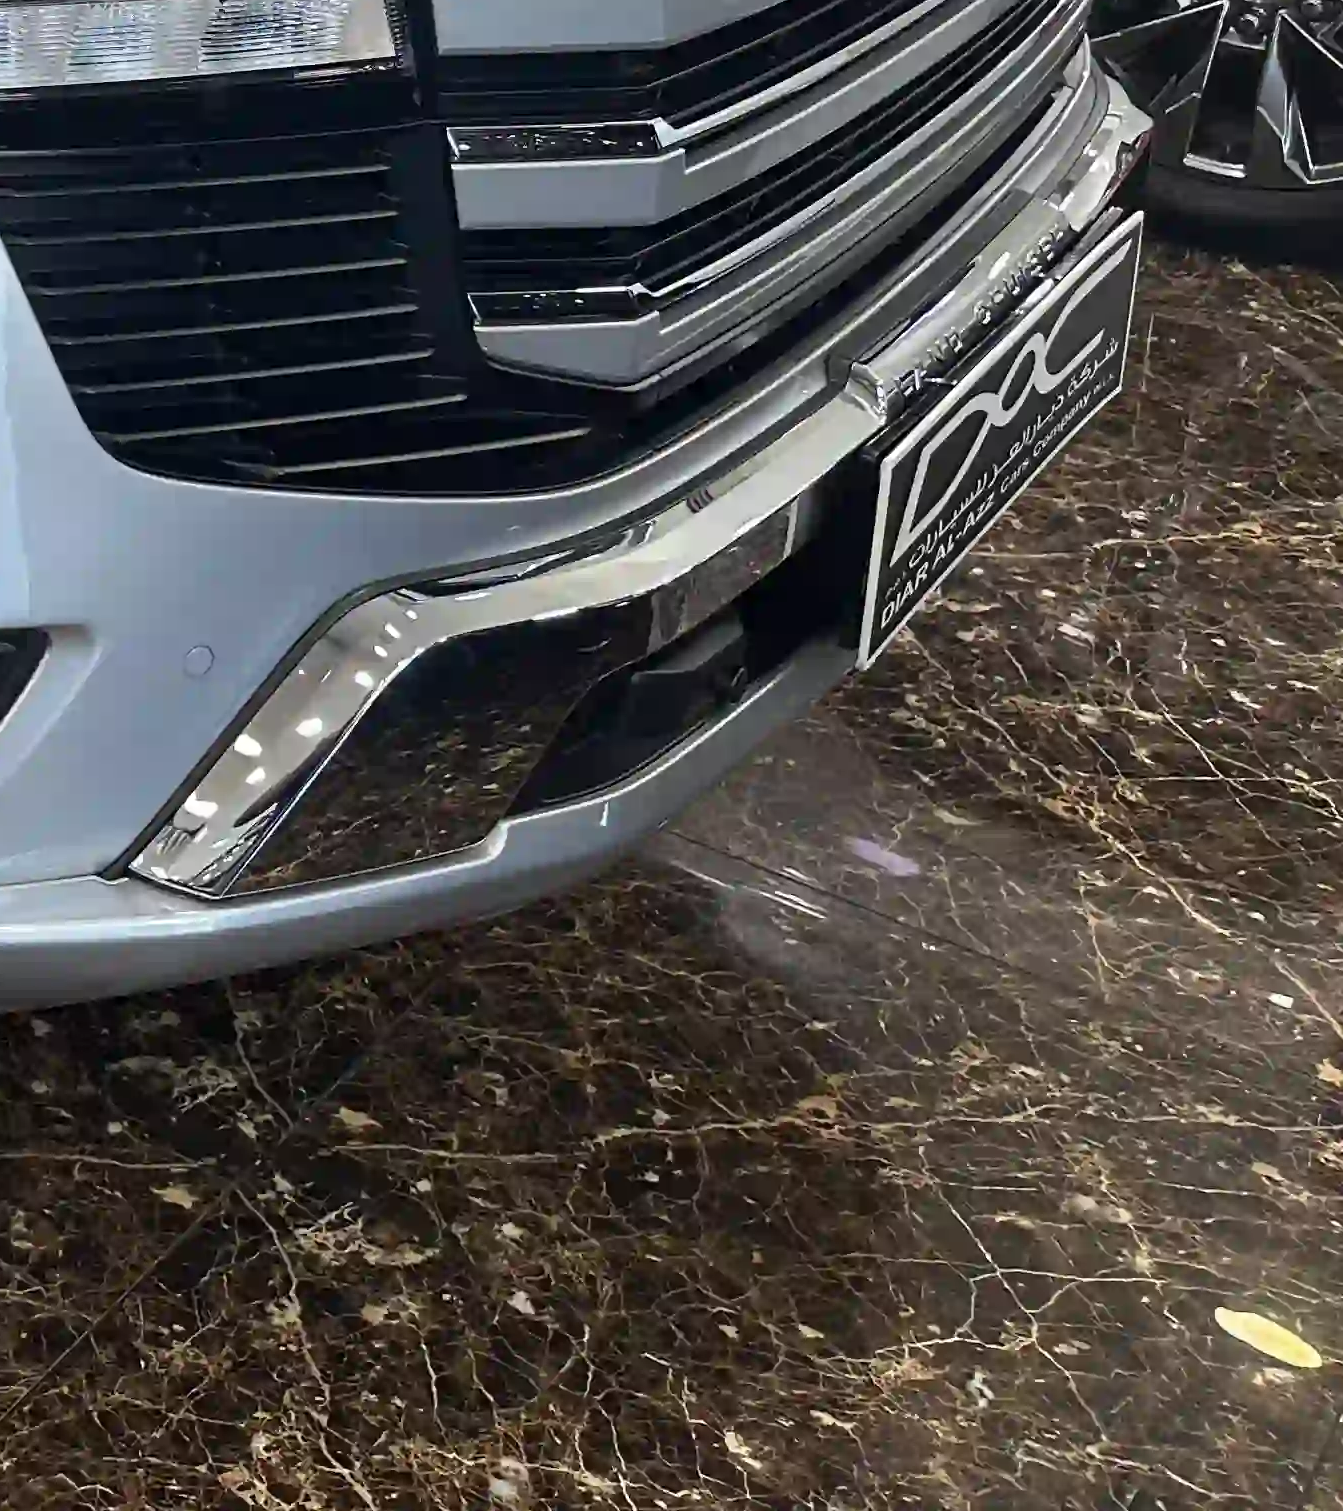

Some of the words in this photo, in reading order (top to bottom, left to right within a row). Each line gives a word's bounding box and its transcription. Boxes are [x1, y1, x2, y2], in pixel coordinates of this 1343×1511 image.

[1067, 336, 1120, 398] شركة
[1029, 394, 1065, 445] ديار
[880, 561, 929, 630] DIAR
[1032, 391, 1092, 458] Company
[908, 471, 988, 569] للسيارات
